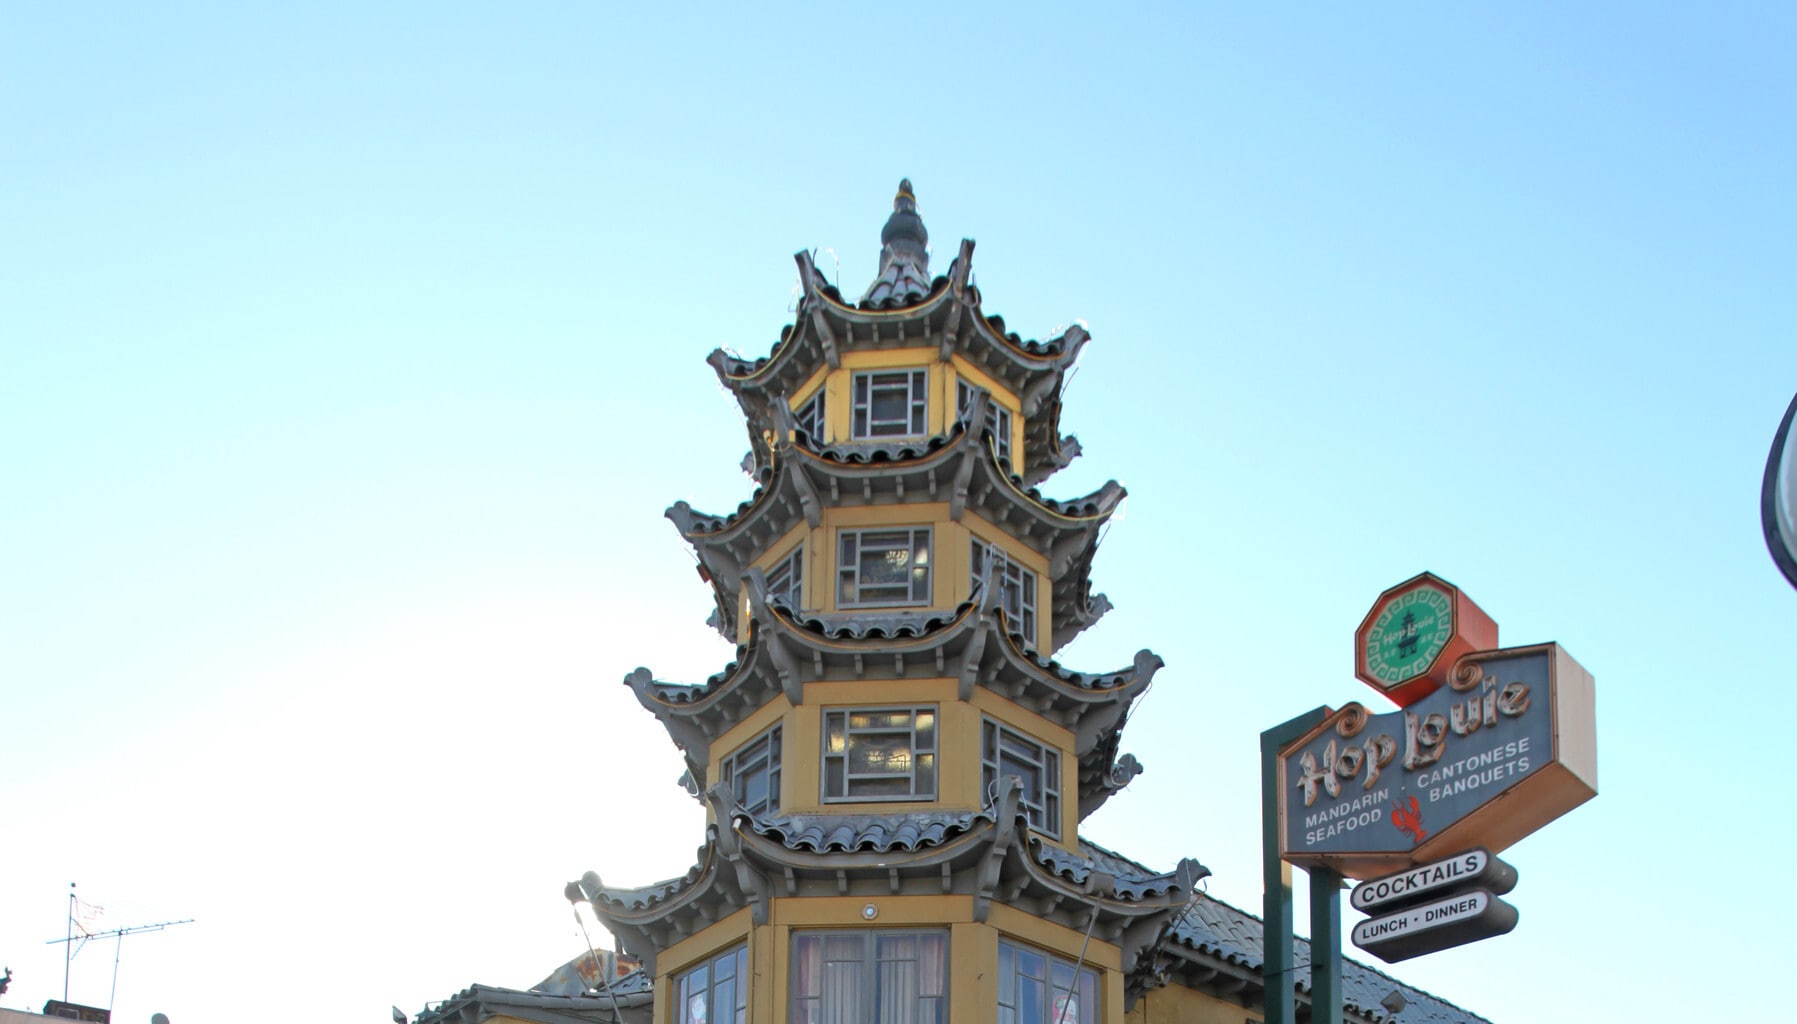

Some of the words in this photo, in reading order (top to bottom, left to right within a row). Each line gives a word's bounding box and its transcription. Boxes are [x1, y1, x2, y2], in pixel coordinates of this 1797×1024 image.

[1296, 734, 1397, 808] Hop
[1402, 674, 1531, 772] Louie
[1305, 788, 1389, 828] MANDARIN
[1417, 737, 1530, 789] CANTONESE
[1305, 808, 1382, 845] SEAFOOD
[1429, 757, 1530, 802] BANQUETS
[1362, 855, 1478, 903] COCKTAILS
[1362, 917, 1408, 939] LUNCH
[1425, 898, 1478, 922] DINNER
